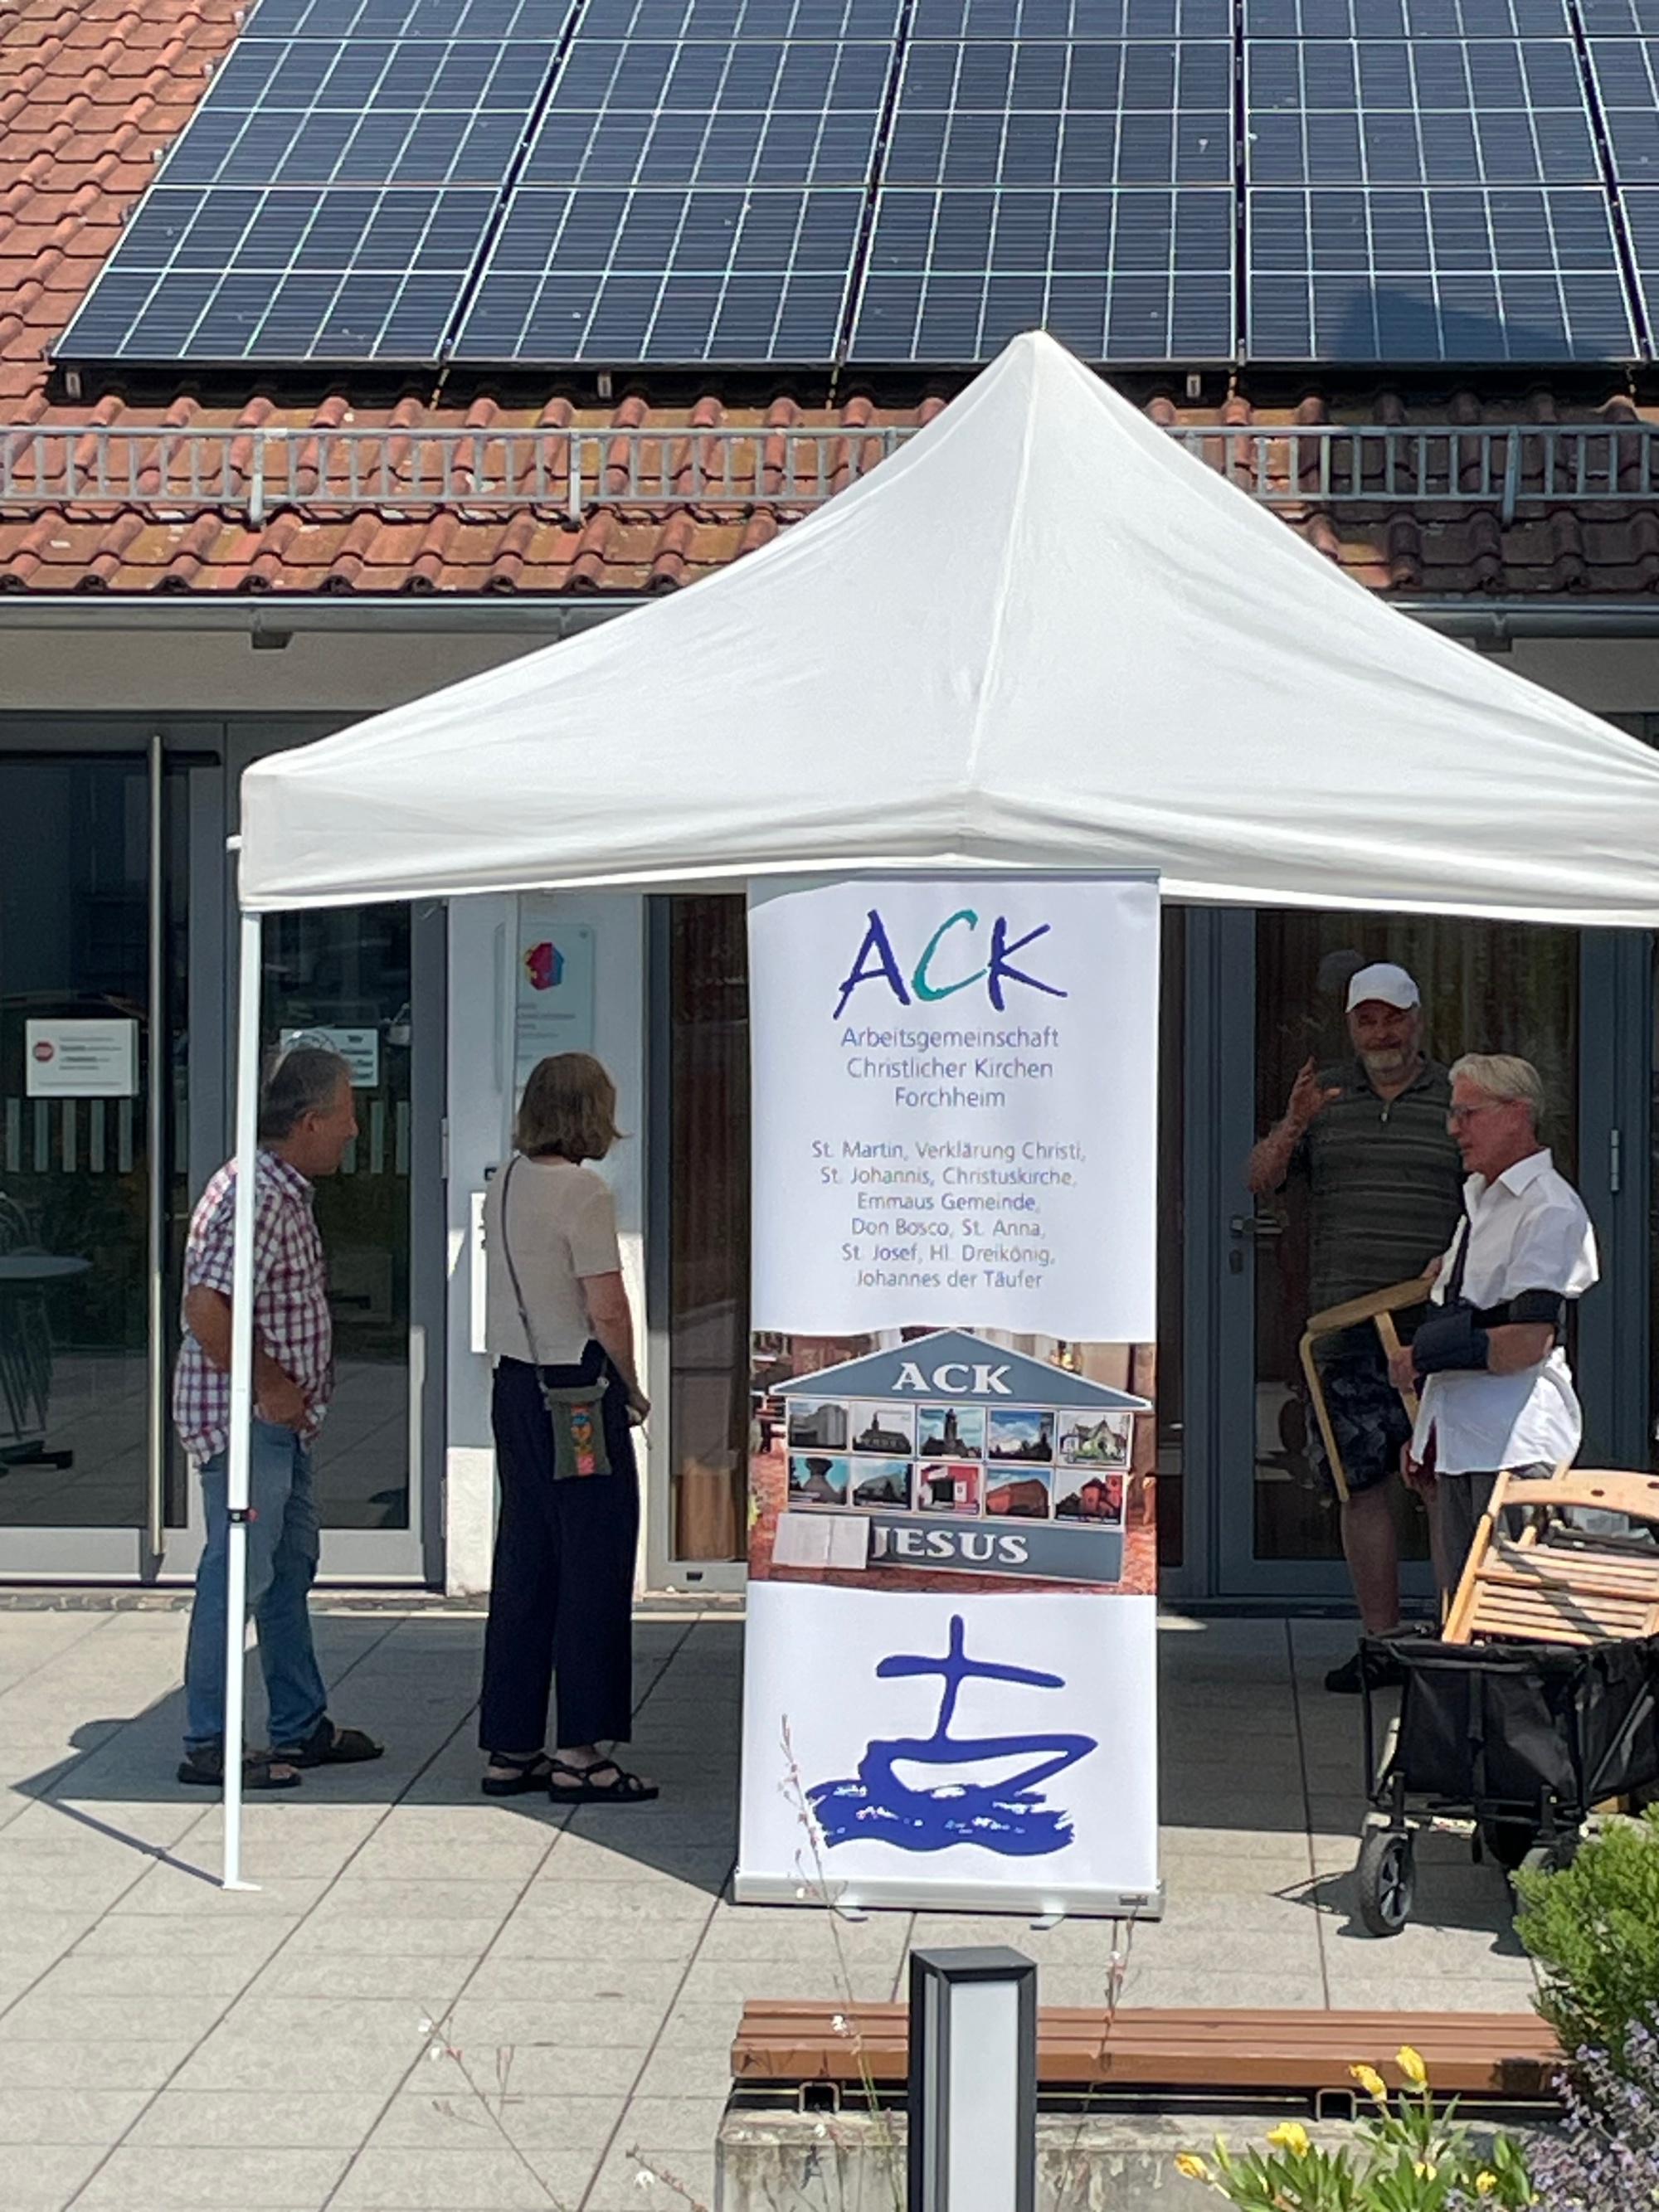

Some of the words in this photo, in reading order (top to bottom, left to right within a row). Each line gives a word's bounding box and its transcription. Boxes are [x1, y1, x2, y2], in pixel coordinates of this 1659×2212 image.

[833, 909, 1068, 1020] ACK
[840, 1026, 1058, 1053] Arbeitsgemeinschaft
[846, 1057, 966, 1078] Christlicher
[975, 1057, 1053, 1078] Kirchen
[895, 1086, 1005, 1108] Forchheim
[811, 1140, 834, 1159] St.
[842, 1140, 908, 1162] Martin,
[915, 1140, 1014, 1163] Verklärung
[1021, 1140, 1086, 1163] Christi,
[820, 1166, 842, 1184] St.
[850, 1166, 935, 1187] Johannis,
[942, 1166, 1077, 1188] Christuskirche,
[857, 1192, 935, 1210] Emmaus
[941, 1192, 1040, 1213] Gemeinde,
[851, 1218, 889, 1236] Don
[896, 1218, 955, 1238] Bosco,
[962, 1218, 985, 1237] St.
[992, 1218, 1046, 1239] Anna,
[871, 1242, 923, 1264] Josef,
[962, 1242, 1056, 1266] Dreikönig,
[856, 1269, 941, 1287] Johannes
[946, 1269, 978, 1288] der
[983, 1270, 1043, 1289] Täufer
[892, 1362, 1013, 1395] ACK
[872, 1526, 1029, 1564] JESUS
